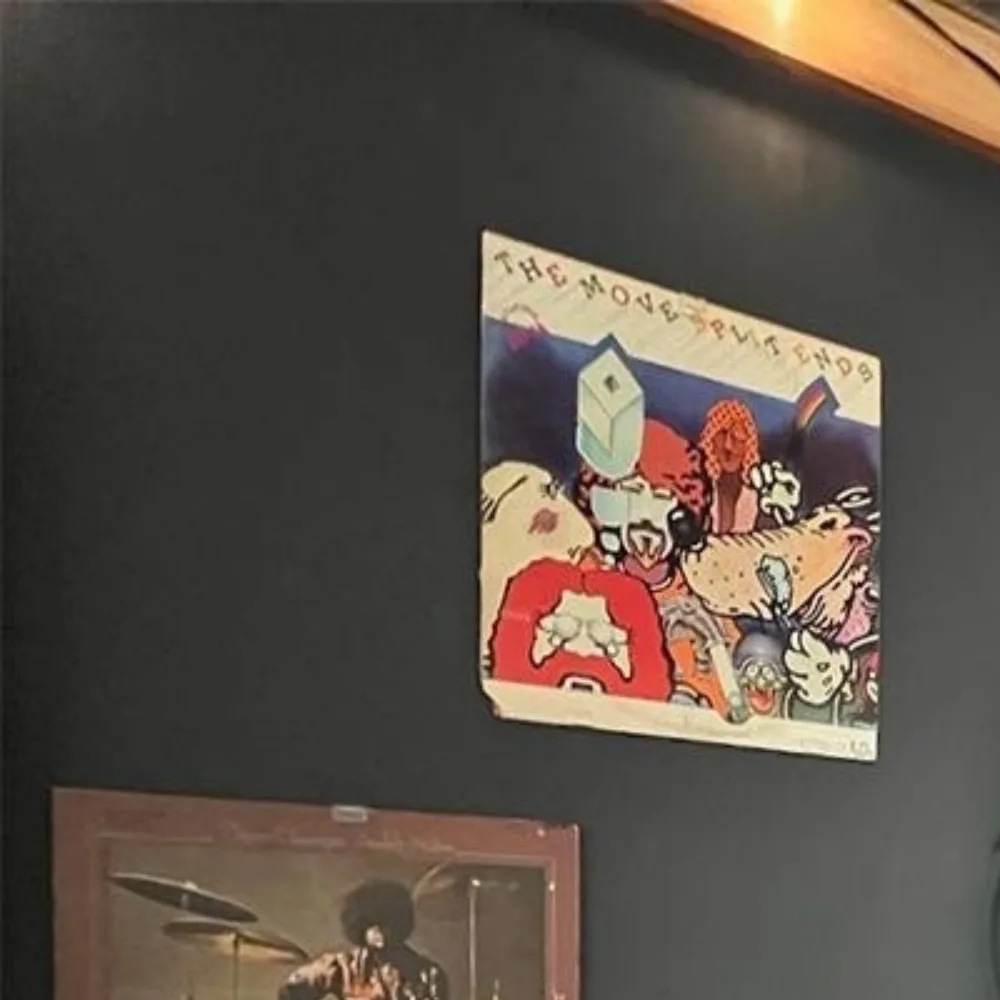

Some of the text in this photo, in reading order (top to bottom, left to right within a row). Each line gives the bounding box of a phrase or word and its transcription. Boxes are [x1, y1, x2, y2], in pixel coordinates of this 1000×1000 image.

[494, 251, 567, 288] THE
[579, 273, 680, 324] MOVE
[793, 342, 875, 385] ENDS
